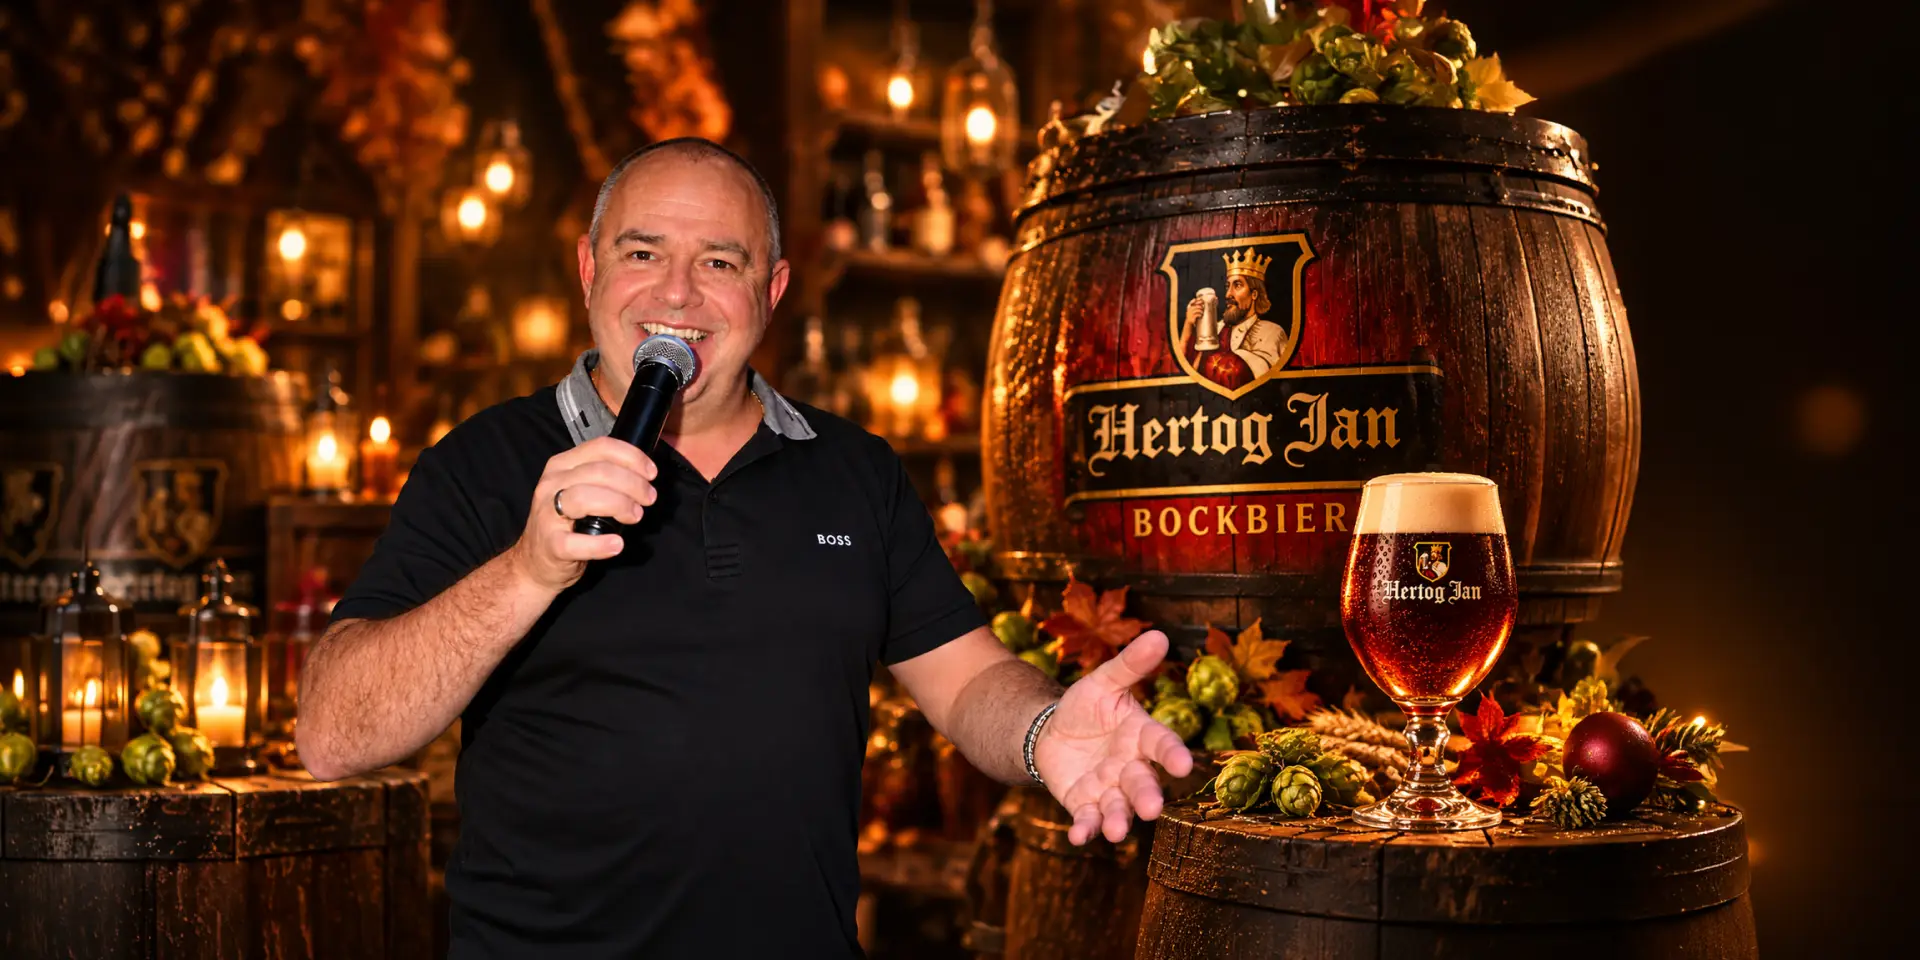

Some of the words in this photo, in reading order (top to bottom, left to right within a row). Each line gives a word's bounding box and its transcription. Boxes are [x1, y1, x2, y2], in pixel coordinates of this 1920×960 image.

[1088, 402, 1273, 477] Hertog
[1284, 392, 1400, 468] Jan
[1133, 502, 1348, 537] BOCKBIER
[817, 534, 852, 546] BOSS
[1382, 580, 1445, 605] Hertog
[1448, 580, 1482, 605] Jan
